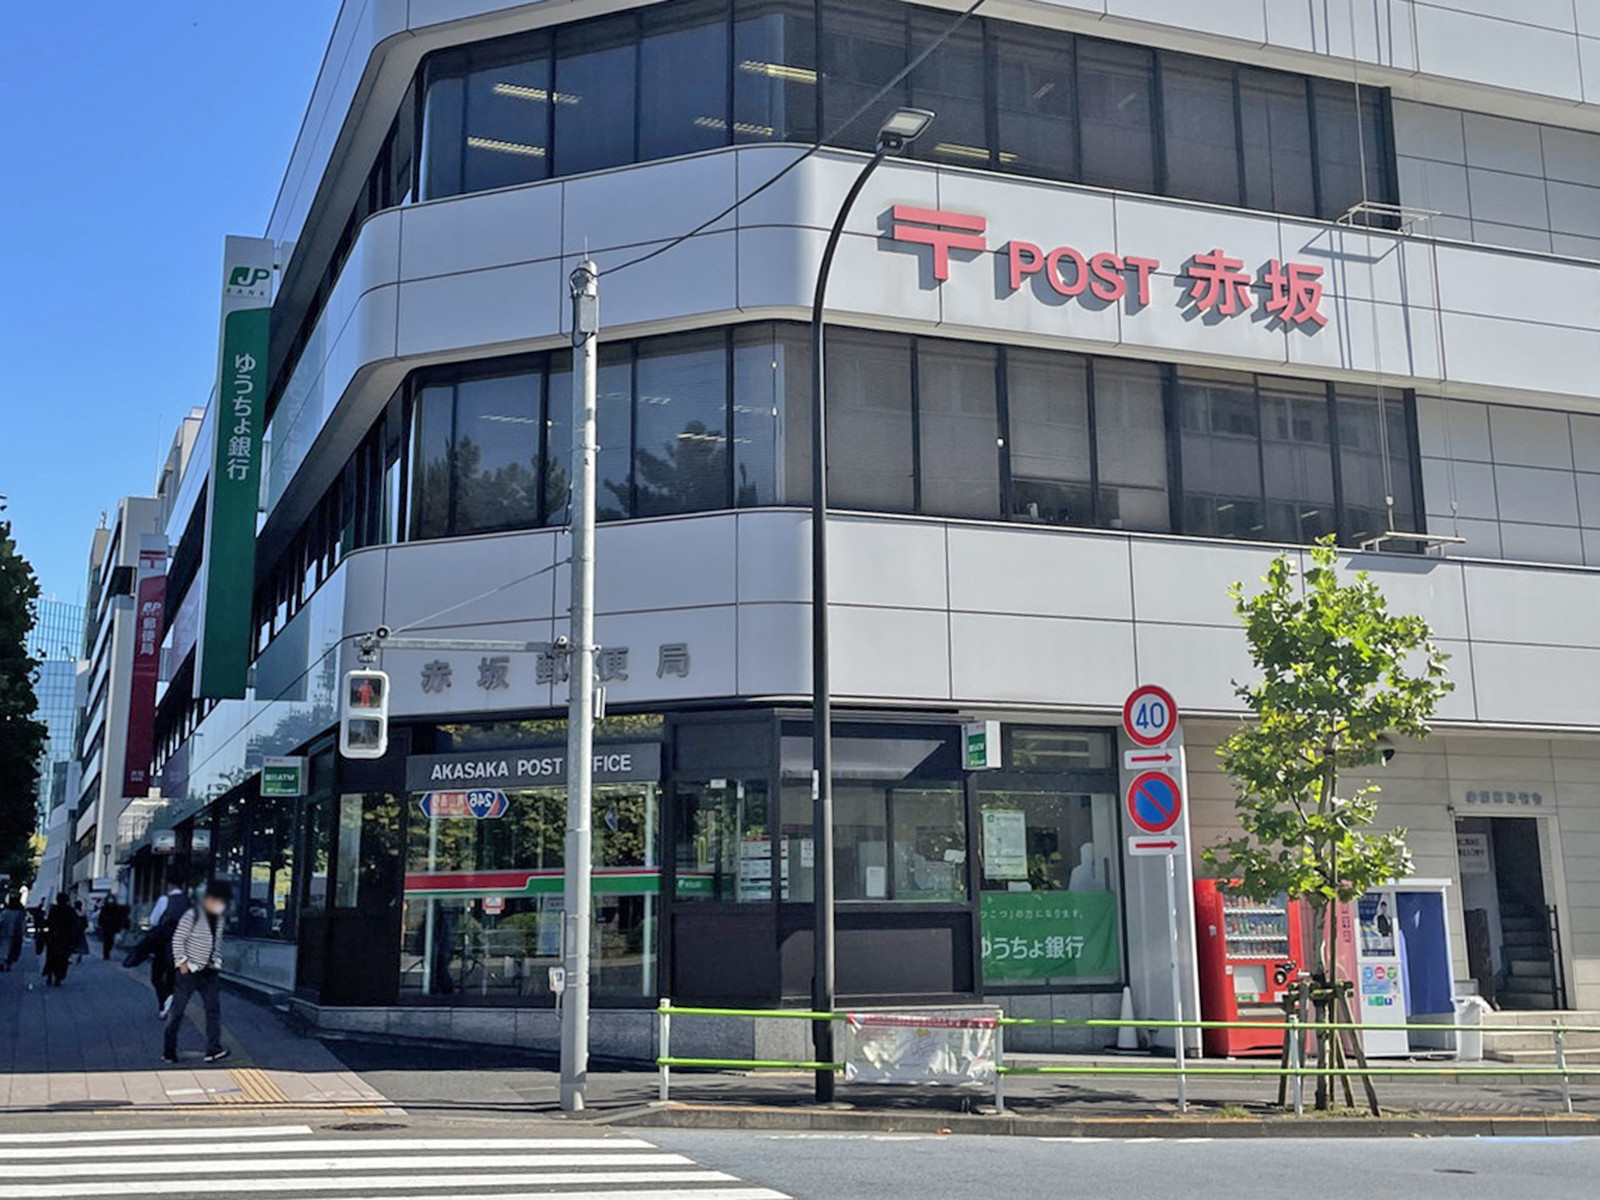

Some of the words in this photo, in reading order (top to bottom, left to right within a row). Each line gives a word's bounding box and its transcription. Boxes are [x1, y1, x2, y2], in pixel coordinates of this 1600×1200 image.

[1009, 241, 1159, 305] POST
[1189, 248, 1329, 327] 赤坂
[226, 354, 256, 480] ゆうちょ銀行
[421, 643, 691, 694] 赤坂郵便局
[1135, 702, 1165, 729] 40
[431, 761, 509, 780] AKASAKA
[517, 757, 563, 776] POST
[592, 754, 632, 773] FICE
